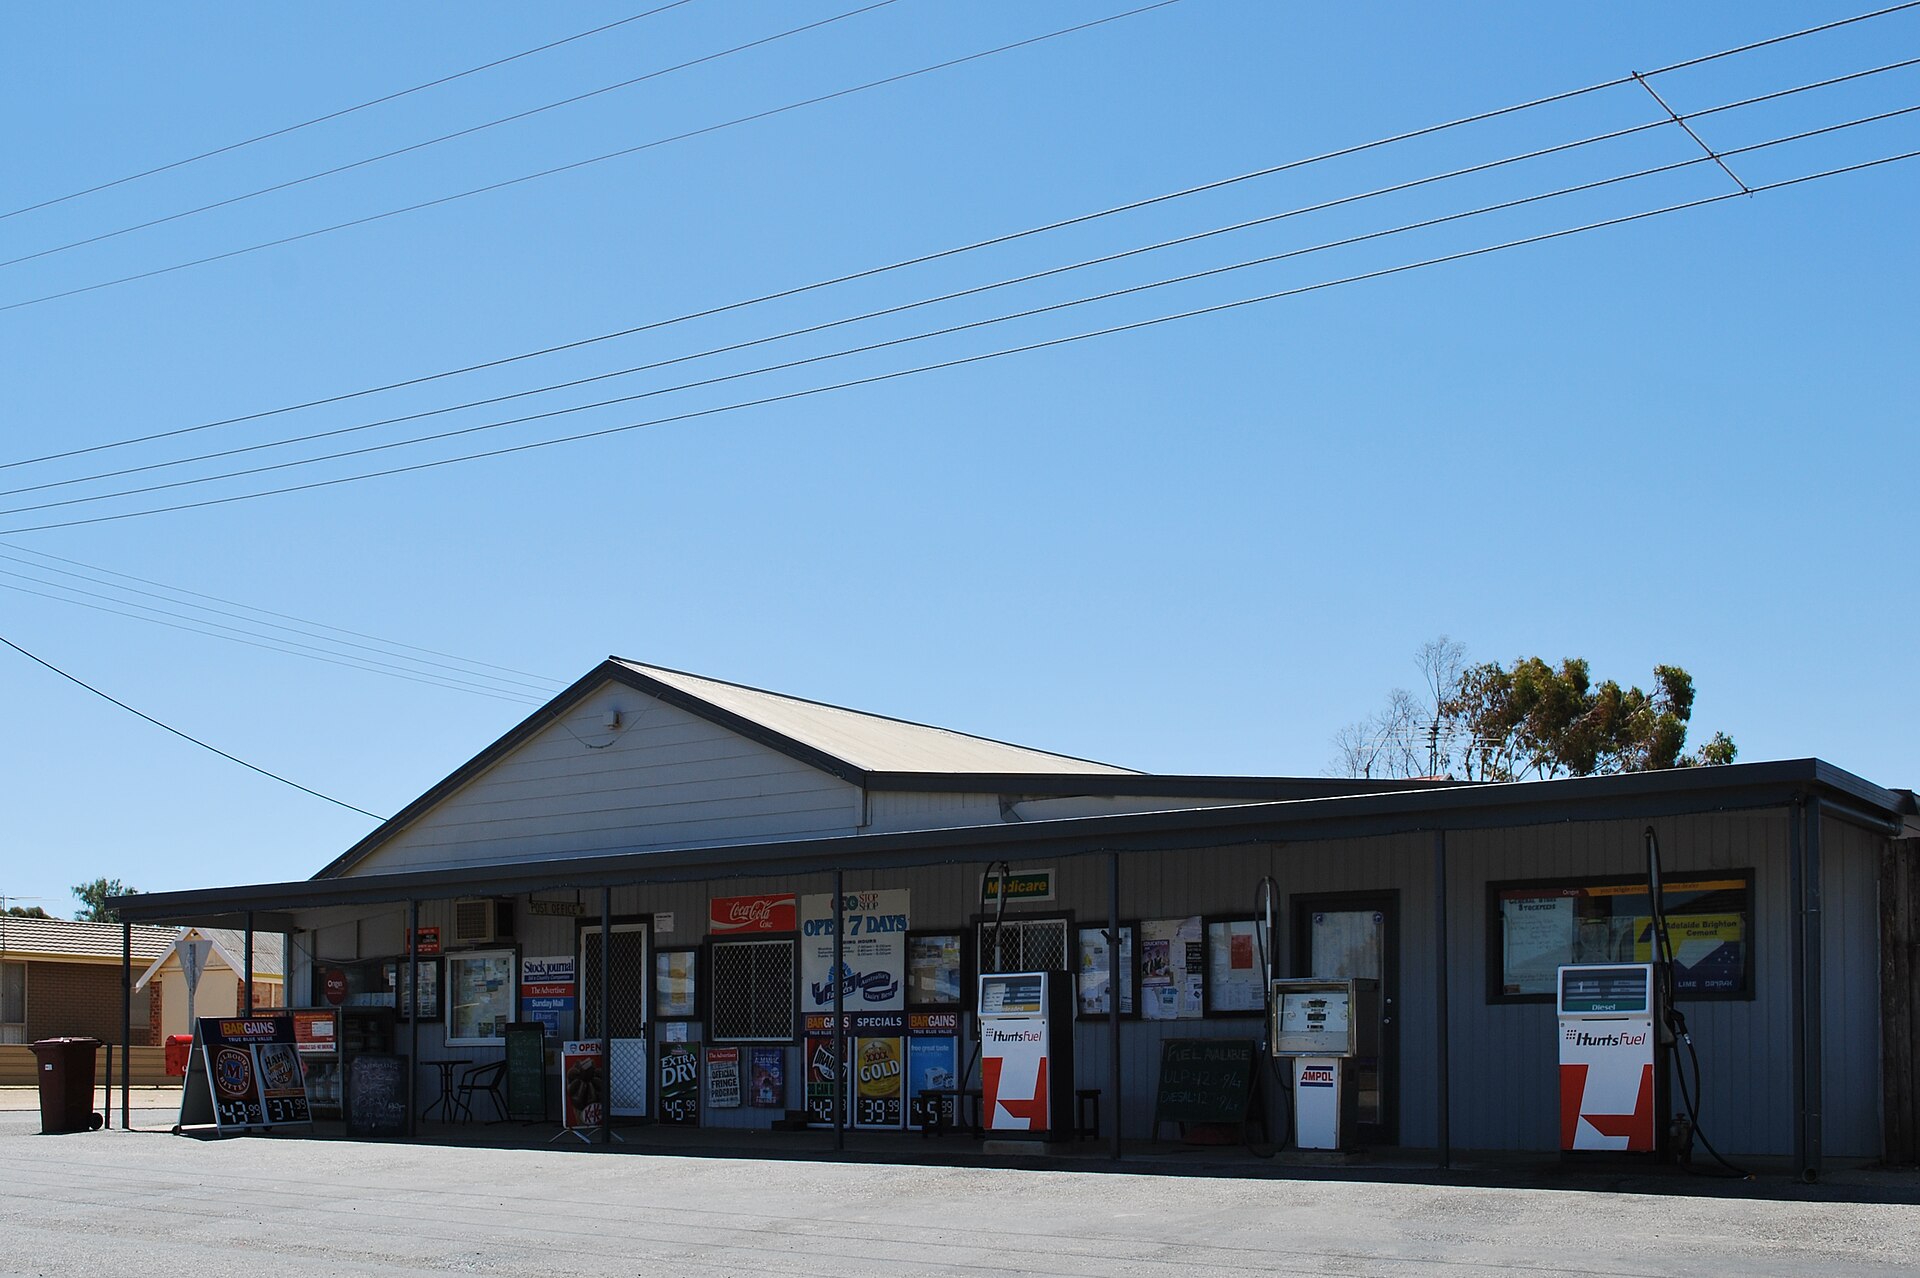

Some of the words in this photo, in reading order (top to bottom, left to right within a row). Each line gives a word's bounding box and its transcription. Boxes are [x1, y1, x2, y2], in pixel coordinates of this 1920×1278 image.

[859, 894, 878, 904] STOP
[531, 903, 547, 914] POST
[859, 903, 878, 911] SHOP
[804, 918, 845, 937] OPE
[848, 915, 863, 935] 7
[866, 914, 907, 933] DAYS
[1702, 920, 1737, 929] Brighton
[524, 960, 546, 974] Stock
[541, 986, 566, 994] Advertiser
[532, 1000, 552, 1008] Sunday
[552, 999, 564, 1007] Mail
[807, 1017, 849, 1028] BARGAS
[857, 1017, 902, 1027] SPECIALS
[911, 1015, 956, 1027] BARGAINS
[222, 1022, 275, 1034] BARGAINS
[579, 1043, 601, 1052] OPEN
[661, 1054, 696, 1068] EXTRA
[866, 1051, 888, 1062] XXXX
[662, 1062, 697, 1088] DRY
[711, 1068, 736, 1078] OFFICIAL
[860, 1060, 900, 1081] GOLD
[1301, 1072, 1333, 1081] AMPOL
[711, 1078, 737, 1088] FRINGE
[711, 1087, 738, 1098] PROGRAM
[268, 1099, 306, 1121] $37.99
[662, 1099, 696, 1121] $45.99
[859, 1099, 899, 1123] $39.99
